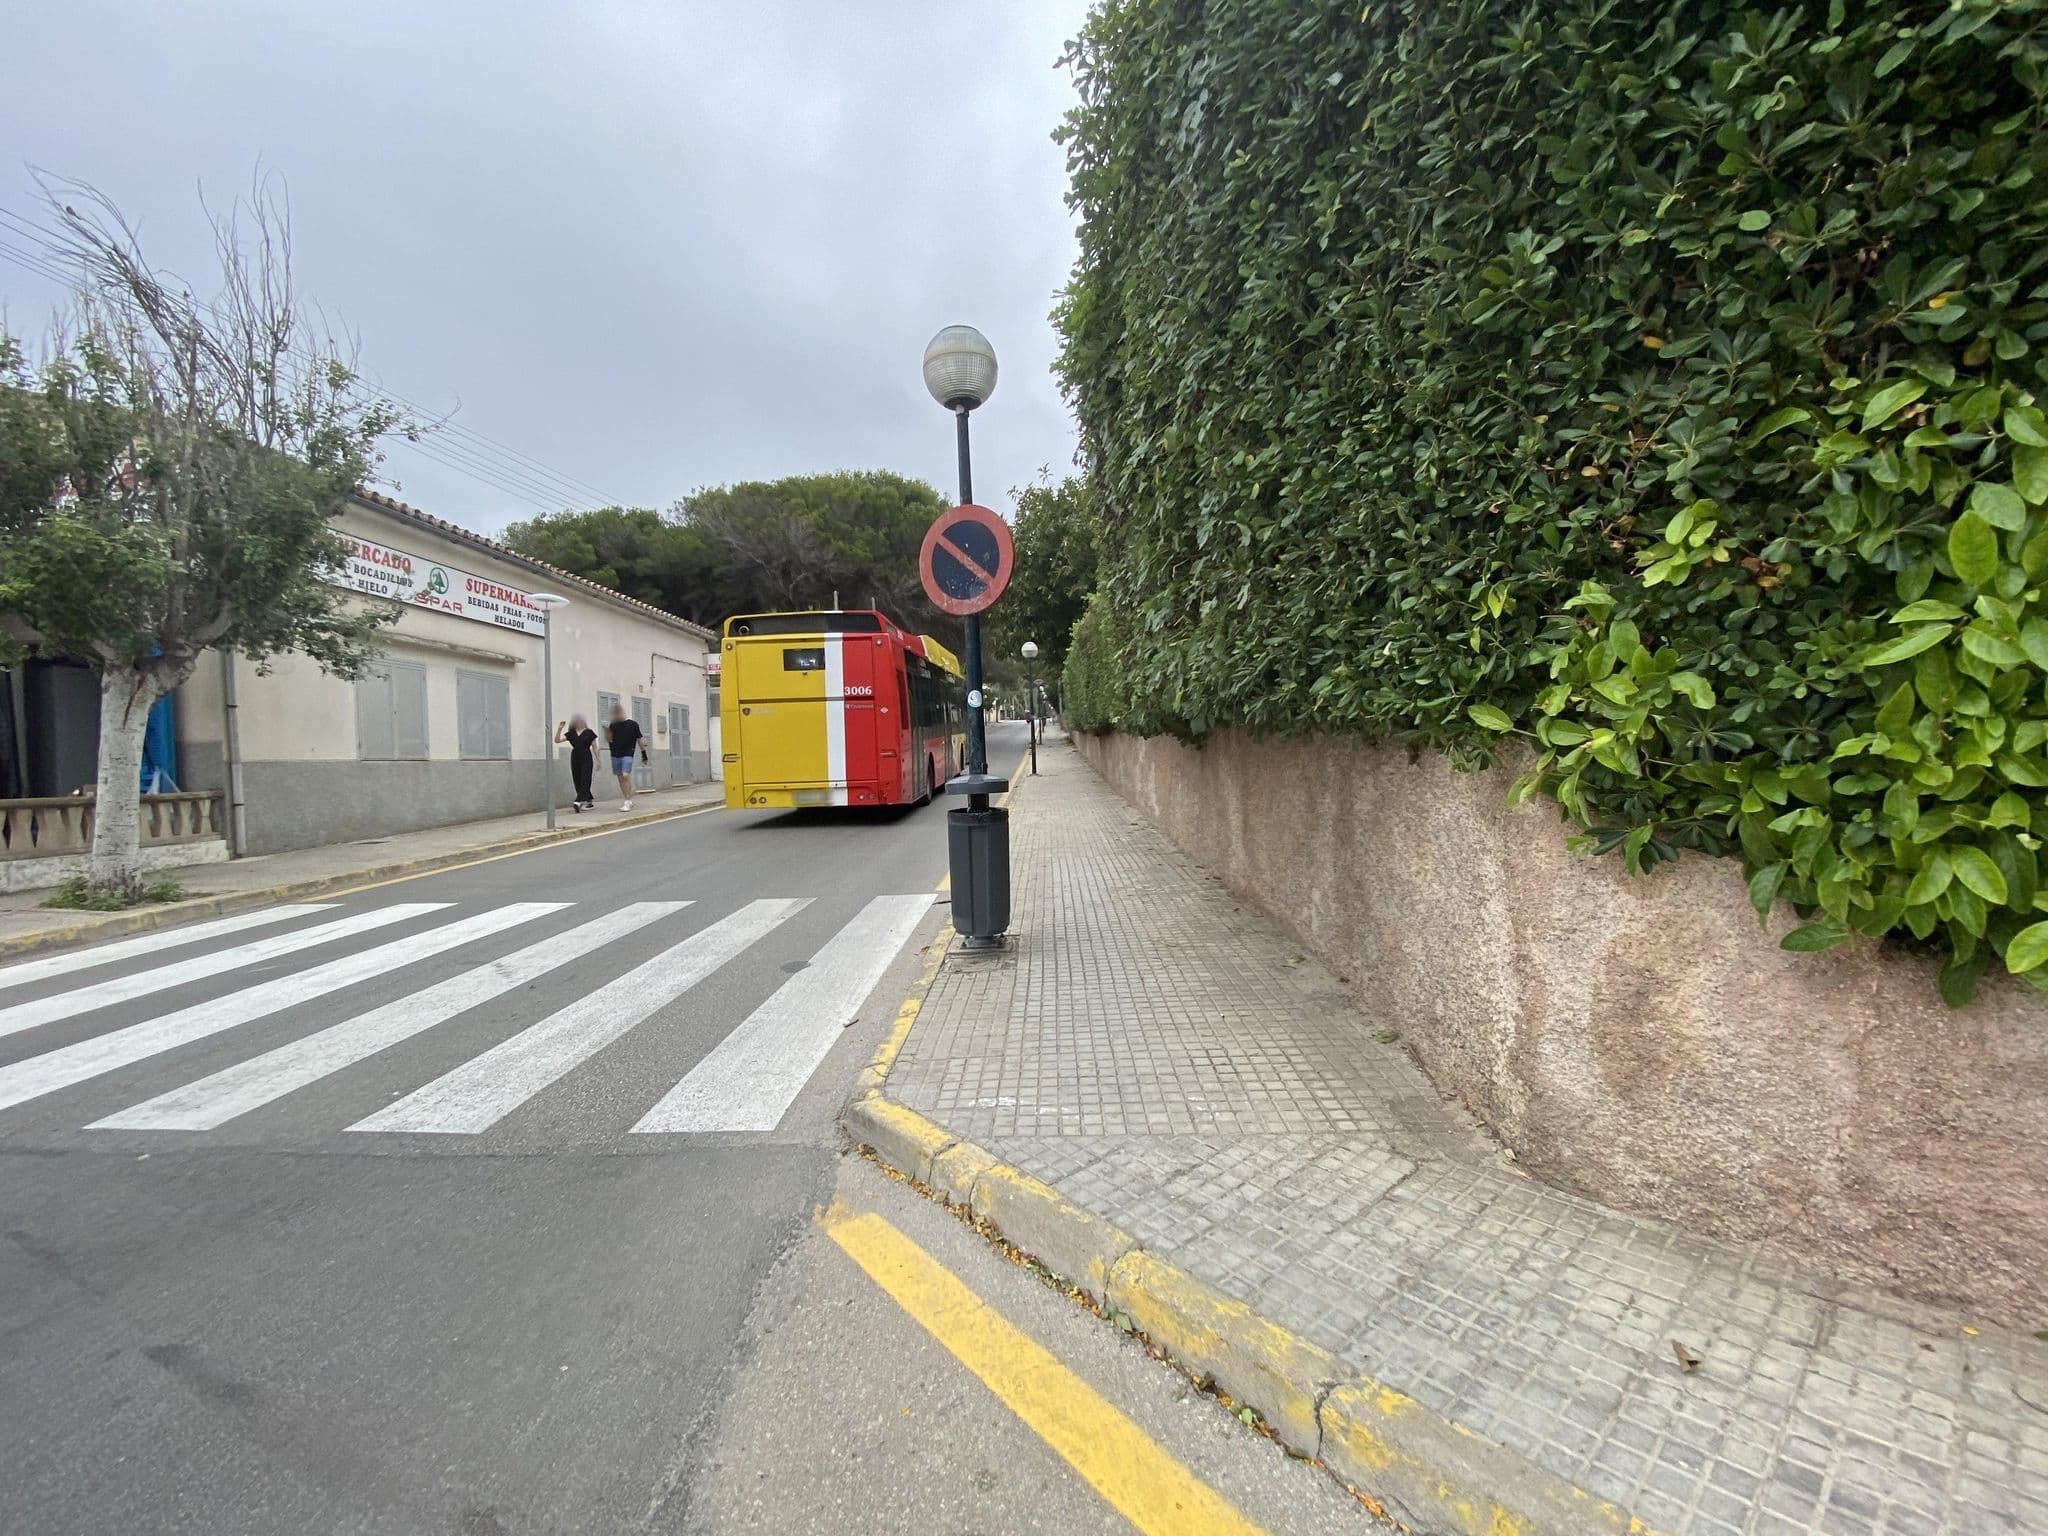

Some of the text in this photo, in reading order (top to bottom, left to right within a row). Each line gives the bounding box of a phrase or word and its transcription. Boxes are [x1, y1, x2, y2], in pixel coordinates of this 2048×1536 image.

[359, 579, 388, 594] HIELO
[466, 578, 540, 611] SUPERMAR
[416, 592, 463, 613] SPAR
[468, 596, 499, 611] BEBIDAS
[503, 606, 522, 618] FRIAS
[494, 615, 525, 629] HELADOS
[844, 686, 872, 696] 3006
